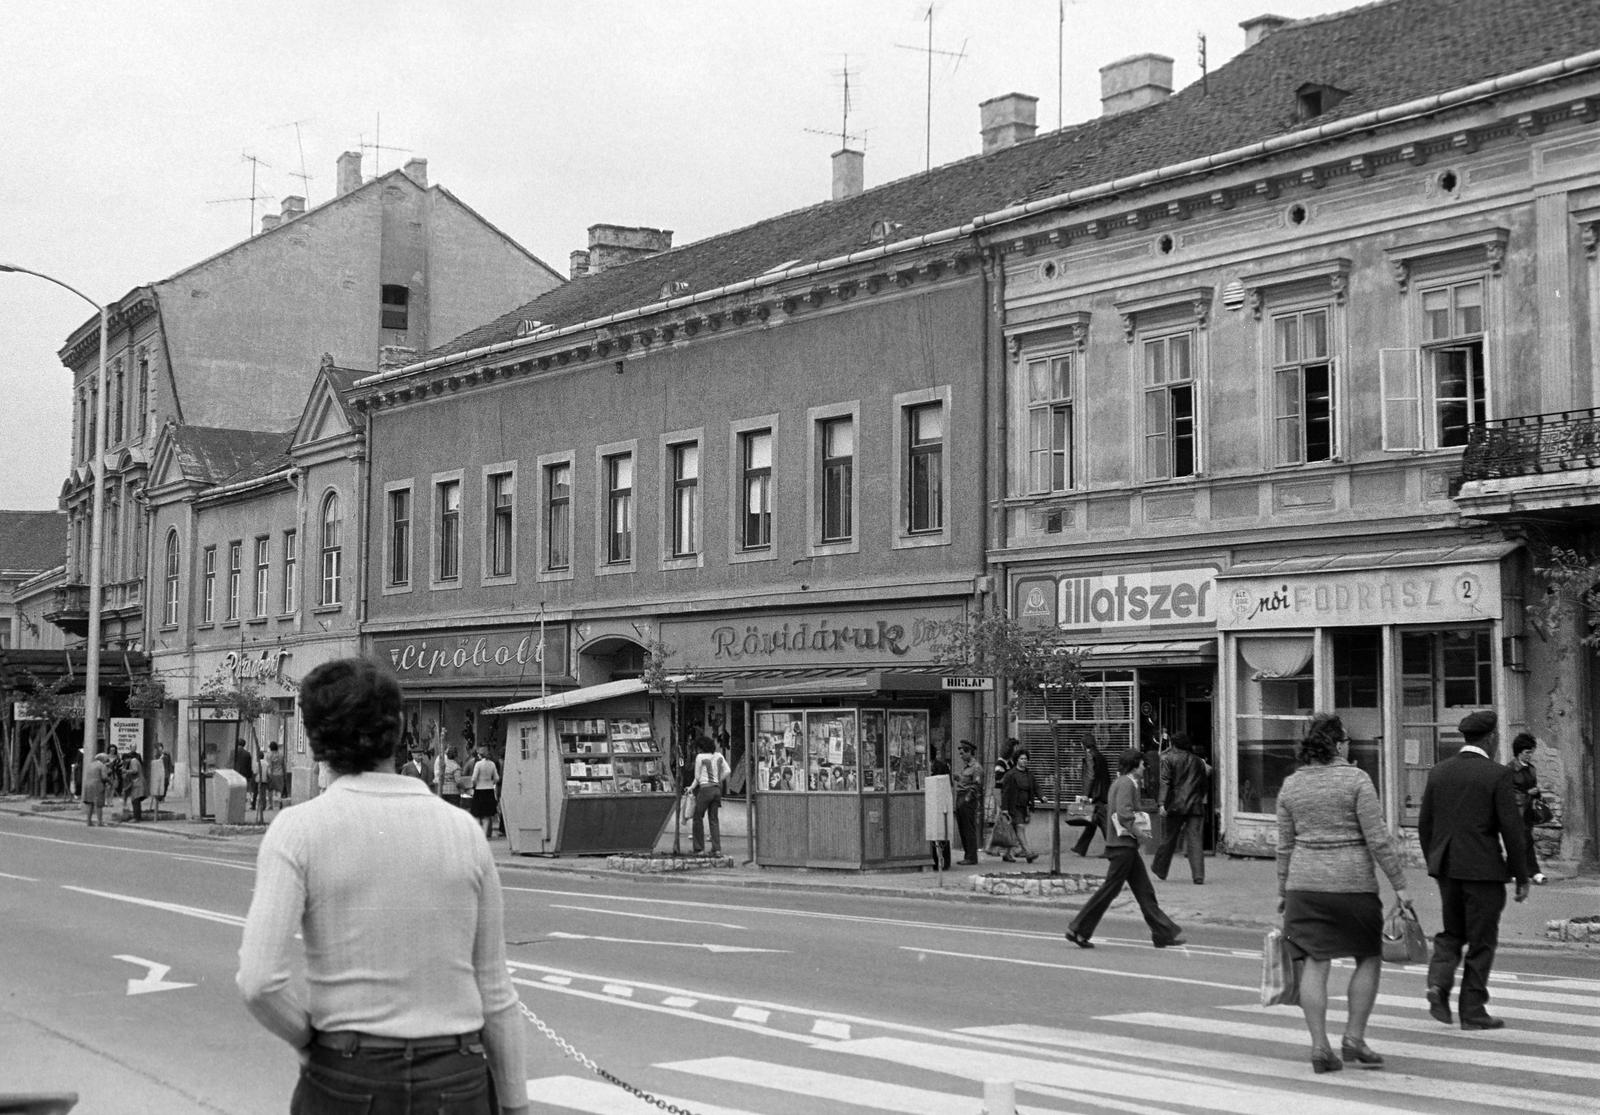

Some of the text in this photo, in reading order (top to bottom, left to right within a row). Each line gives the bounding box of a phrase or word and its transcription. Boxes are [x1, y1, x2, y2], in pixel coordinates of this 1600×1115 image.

[1065, 576, 1212, 625] illatszer
[1462, 580, 1473, 599] 2
[396, 634, 546, 675] Cipőbolt
[711, 619, 910, 658] Rövidáruk
